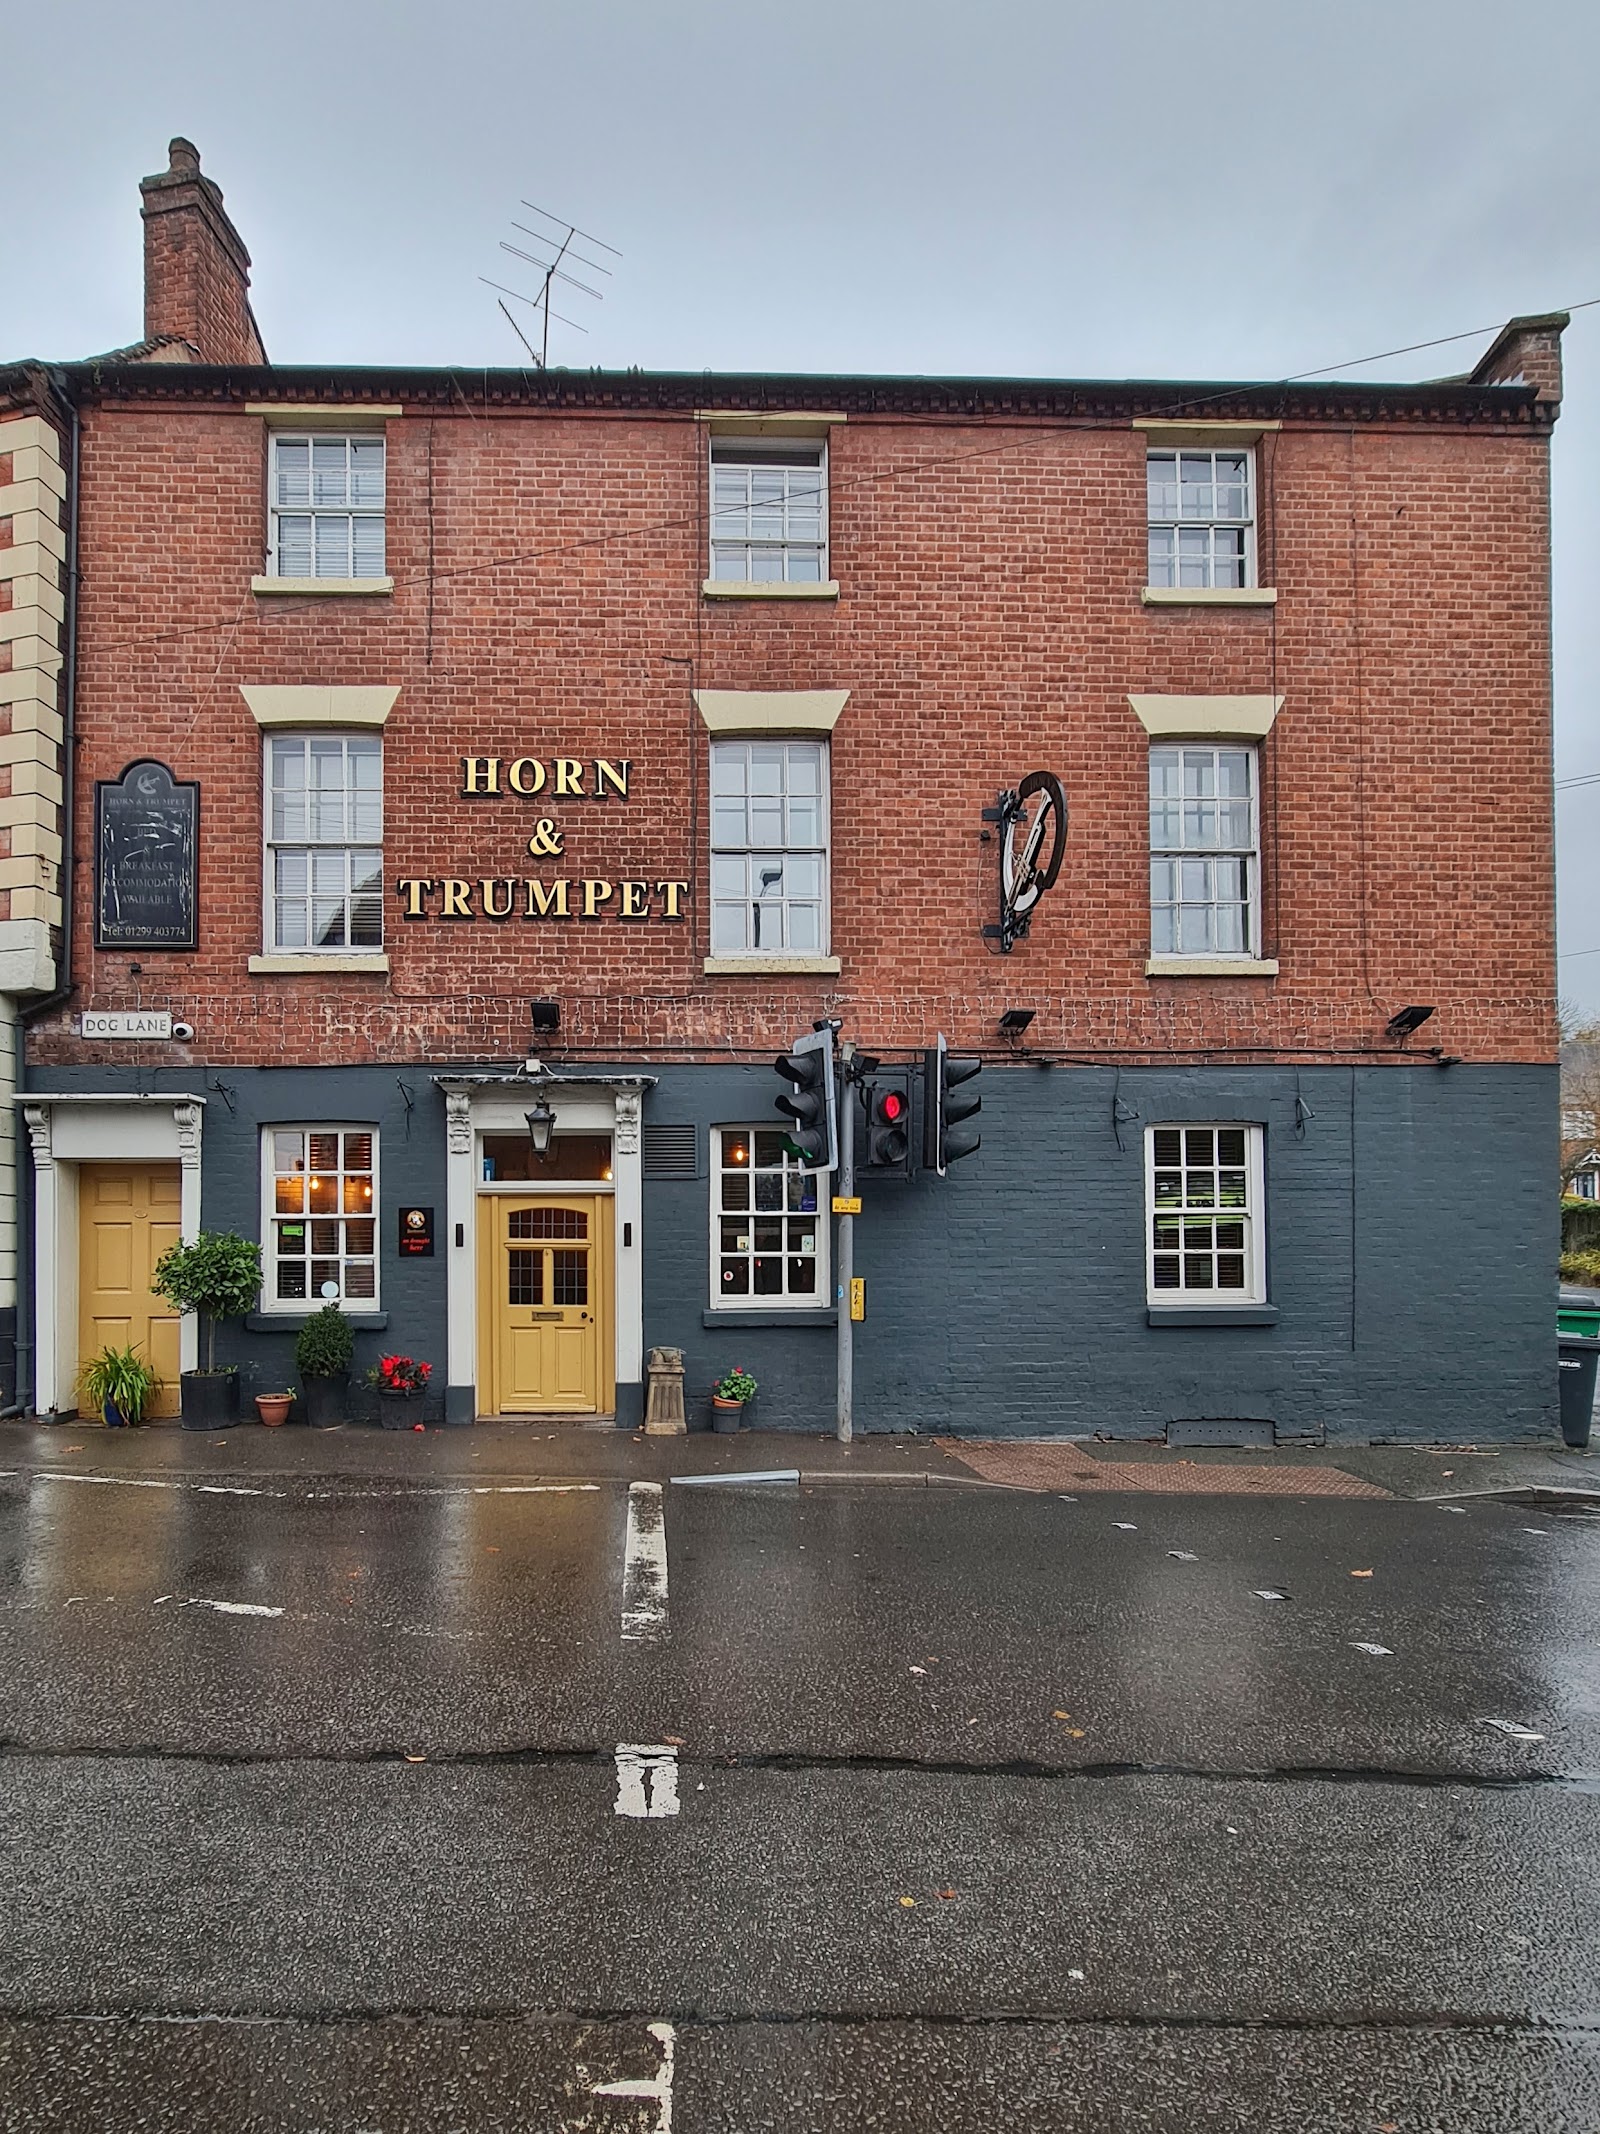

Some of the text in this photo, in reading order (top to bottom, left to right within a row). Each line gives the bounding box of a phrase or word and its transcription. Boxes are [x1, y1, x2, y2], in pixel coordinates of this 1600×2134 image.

[461, 757, 630, 799] HORN
[529, 818, 564, 857] &
[119, 861, 175, 871] BREAKFAST
[106, 878, 189, 888] ACCOMMODATION
[121, 894, 173, 904] AVAILABLE
[398, 878, 690, 920] TRUMPET
[107, 926, 185, 937] Tel: 01299 403774
[86, 1019, 167, 1032] DOG LANE
